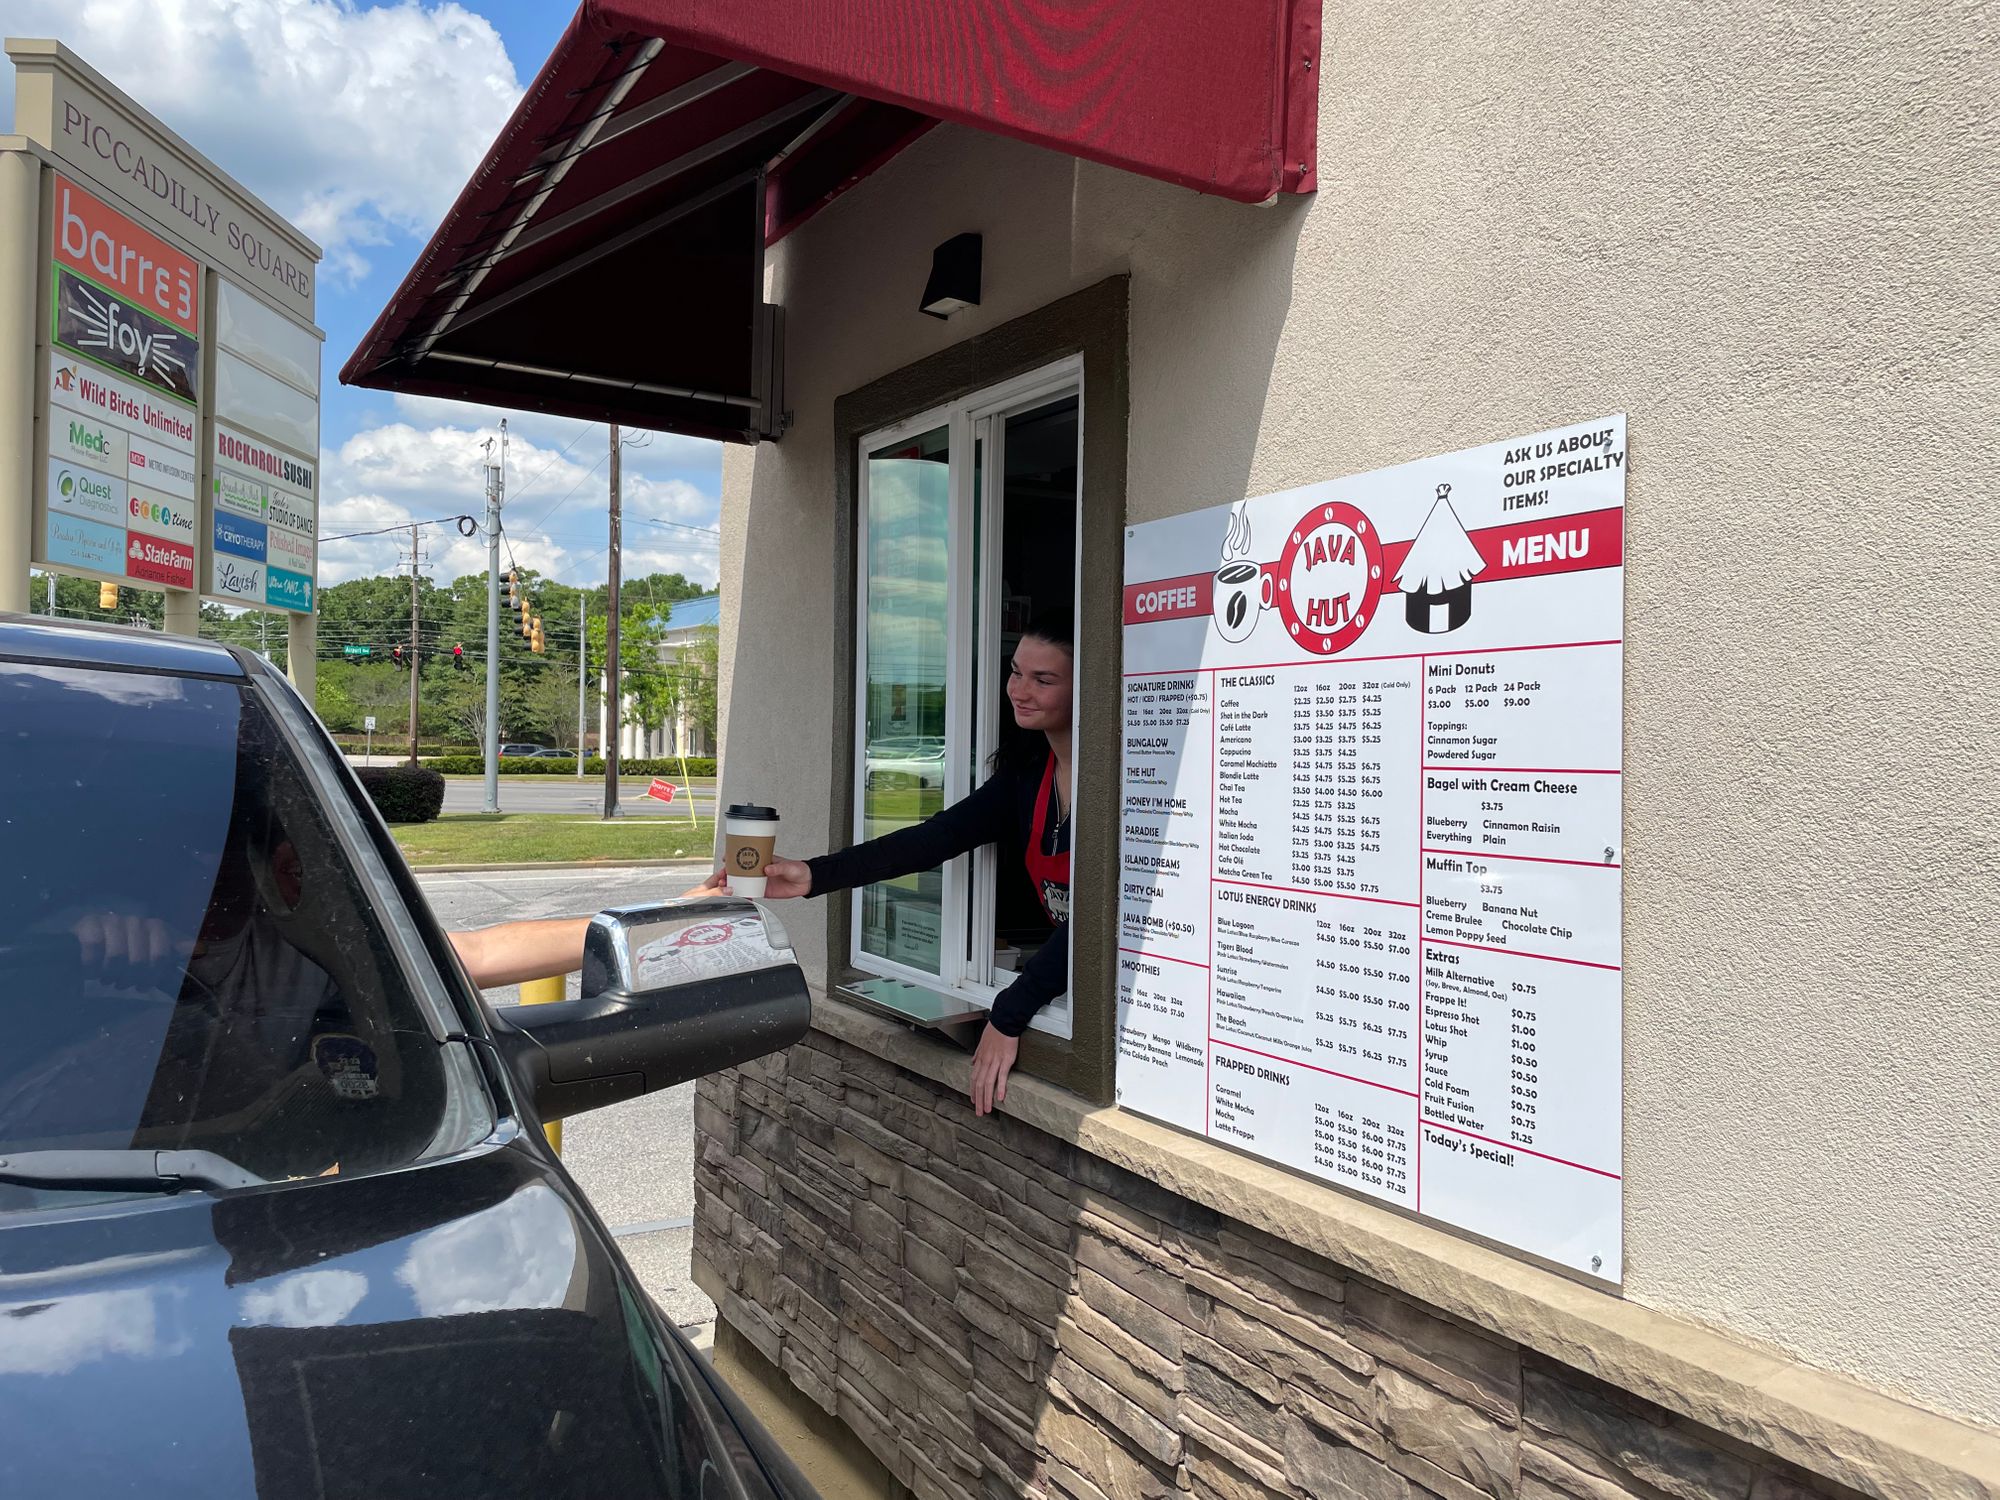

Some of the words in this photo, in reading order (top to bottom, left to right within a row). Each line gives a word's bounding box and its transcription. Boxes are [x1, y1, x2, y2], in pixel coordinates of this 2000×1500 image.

[64, 100, 220, 236] PICCADILLY
[228, 222, 309, 298] SQUARE
[108, 302, 152, 376] foy
[80, 378, 106, 407] Wild
[110, 390, 139, 420] Birds
[144, 404, 192, 441] Unlimited
[1504, 446, 1531, 465] ASK
[1536, 442, 1553, 459] US
[1557, 429, 1614, 454] ABOUT
[1504, 469, 1535, 487] OUR
[1540, 451, 1624, 481] SPECIALTY
[80, 477, 111, 500] Quest
[80, 495, 119, 514] Diagnostics
[1503, 490, 1548, 511] ITEMS!
[172, 512, 192, 530] time
[270, 506, 288, 525] STUDIO
[289, 513, 296, 527] OF
[297, 516, 312, 534] DANCE
[224, 531, 264, 551] CRYOTHERAPY
[1502, 528, 1590, 567] MENU
[1304, 534, 1356, 572] JAVA
[217, 562, 259, 593] Lavish
[1136, 586, 1196, 614] COFFEE
[1306, 593, 1350, 627] HUT
[1428, 664, 1452, 677] Mini
[1455, 663, 1495, 676] Donuts
[1128, 682, 1165, 692] SIGNATURE
[1168, 680, 1194, 690] DRINKS
[1221, 678, 1237, 688] THE
[1239, 675, 1275, 687] CLASSICS
[1428, 686, 1433, 694] 6
[1436, 685, 1456, 694] Pack
[1465, 685, 1473, 693] 12
[1476, 684, 1498, 693] Pack
[1504, 683, 1514, 692] 24
[1517, 681, 1541, 691] Pack
[1428, 700, 1451, 709] $3.00
[1465, 699, 1489, 708] $5.00
[1504, 698, 1530, 707] $9.00
[1428, 722, 1467, 731] Toppings:
[1127, 738, 1168, 747] BUNGALOW
[1428, 736, 1470, 745] Cinnamon
[1472, 736, 1497, 746] Sugar
[1428, 750, 1469, 759] Powdered
[1471, 750, 1496, 760] Sugar
[1127, 768, 1139, 777] THE
[1141, 768, 1155, 777] HUT
[1428, 778, 1458, 792] Bagel
[1462, 778, 1486, 791] with
[1491, 779, 1530, 792] Cream
[1534, 780, 1577, 794] Cheese
[1126, 796, 1150, 806] HONEY
[1152, 798, 1163, 807] I'M
[1165, 799, 1186, 808] HOME
[1481, 802, 1503, 811] $3.75
[1126, 825, 1159, 837] PARADISE
[1427, 817, 1467, 828] Blueberry
[1483, 820, 1529, 831] Cinnamon
[1532, 823, 1560, 833] Raisin
[1427, 831, 1472, 844] Everything
[1483, 835, 1506, 845] Plain
[1125, 855, 1148, 865] ISLAND
[1151, 857, 1180, 869] DREAMS
[1426, 858, 1462, 872] Muffin
[1466, 862, 1487, 876] Top
[1124, 884, 1144, 894] DIRTY
[1146, 887, 1163, 898] CHAI
[1481, 884, 1502, 895] $3.75
[1218, 890, 1243, 901] LOTUS
[1246, 893, 1280, 908] ENERGY
[1283, 898, 1317, 913] DRINKS
[1426, 896, 1467, 910] Blueberry
[1482, 903, 1517, 916] Banana
[1520, 907, 1538, 918] Nut
[1123, 913, 1140, 924] JAVA
[1142, 915, 1164, 928] BOMB
[1166, 920, 1194, 935] (+$0.50)
[1426, 910, 1452, 922] Creme
[1455, 914, 1482, 926] Brulee
[1502, 920, 1547, 934] Chocolate
[1550, 926, 1572, 939] Chip
[1426, 924, 1453, 936] Lemon
[1456, 930, 1484, 942] Poppy
[1486, 932, 1506, 944] Seed
[1426, 948, 1460, 964] Extras
[1122, 960, 1160, 976] SMOOTHIES
[1426, 966, 1443, 978] Milk
[1446, 970, 1495, 987] Alternative
[1512, 983, 1536, 994] $0.75
[1216, 988, 1246, 1001] Hawaiian
[1426, 992, 1455, 1006] Frappe
[1458, 998, 1466, 1007] It!
[1463, 986, 1490, 998] Almond,
[1426, 1006, 1459, 1021] Espresso
[1462, 1013, 1480, 1025] Shot
[1511, 1024, 1536, 1036] $1.00
[1426, 1020, 1447, 1033] Lotus
[1450, 1025, 1467, 1037] Shot
[1120, 1025, 1147, 1039] Strawberry
[1152, 1034, 1171, 1045] Mango
[1176, 1040, 1203, 1056] Wildberry
[1425, 1034, 1447, 1048] Whip
[1216, 1056, 1255, 1076] FRAPPED
[1257, 1068, 1290, 1086] DRINKS
[1425, 1049, 1448, 1062] Syrup
[1511, 1069, 1537, 1083] $0.50
[1425, 1063, 1448, 1076] Sauce
[1425, 1078, 1443, 1090] Cold
[1445, 1083, 1470, 1097] Foam
[1425, 1092, 1445, 1105] Fruit
[1447, 1099, 1474, 1113] Fusion
[1425, 1106, 1455, 1122] Bottled
[1457, 1115, 1484, 1130] Water
[1511, 1131, 1533, 1144] $1.25
[1424, 1129, 1466, 1152] Today's
[1470, 1143, 1514, 1167] Special!
